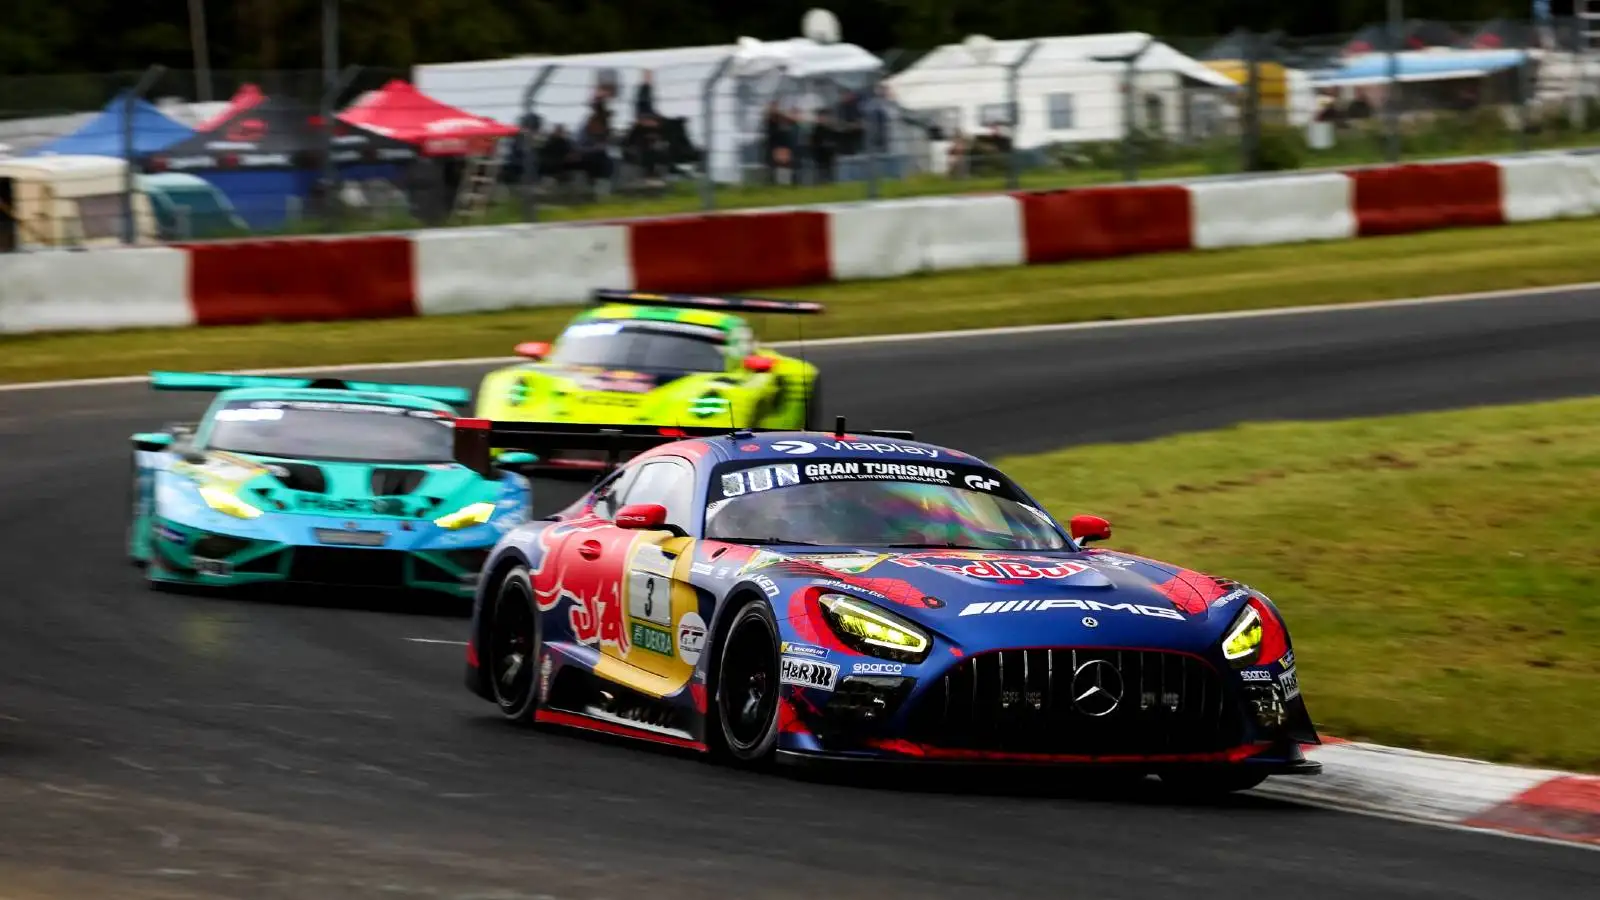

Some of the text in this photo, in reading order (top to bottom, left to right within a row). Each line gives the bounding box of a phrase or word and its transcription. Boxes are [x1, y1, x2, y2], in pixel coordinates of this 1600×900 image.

[805, 462, 948, 479] GRAN TURISMO
[897, 475, 950, 485] SIMULATOR
[721, 464, 801, 498] JUN
[644, 577, 655, 617] 3
[1036, 600, 1187, 621] AMG
[782, 659, 810, 680] H&R
[852, 662, 903, 675] sparco
[1240, 670, 1271, 681] sparco
